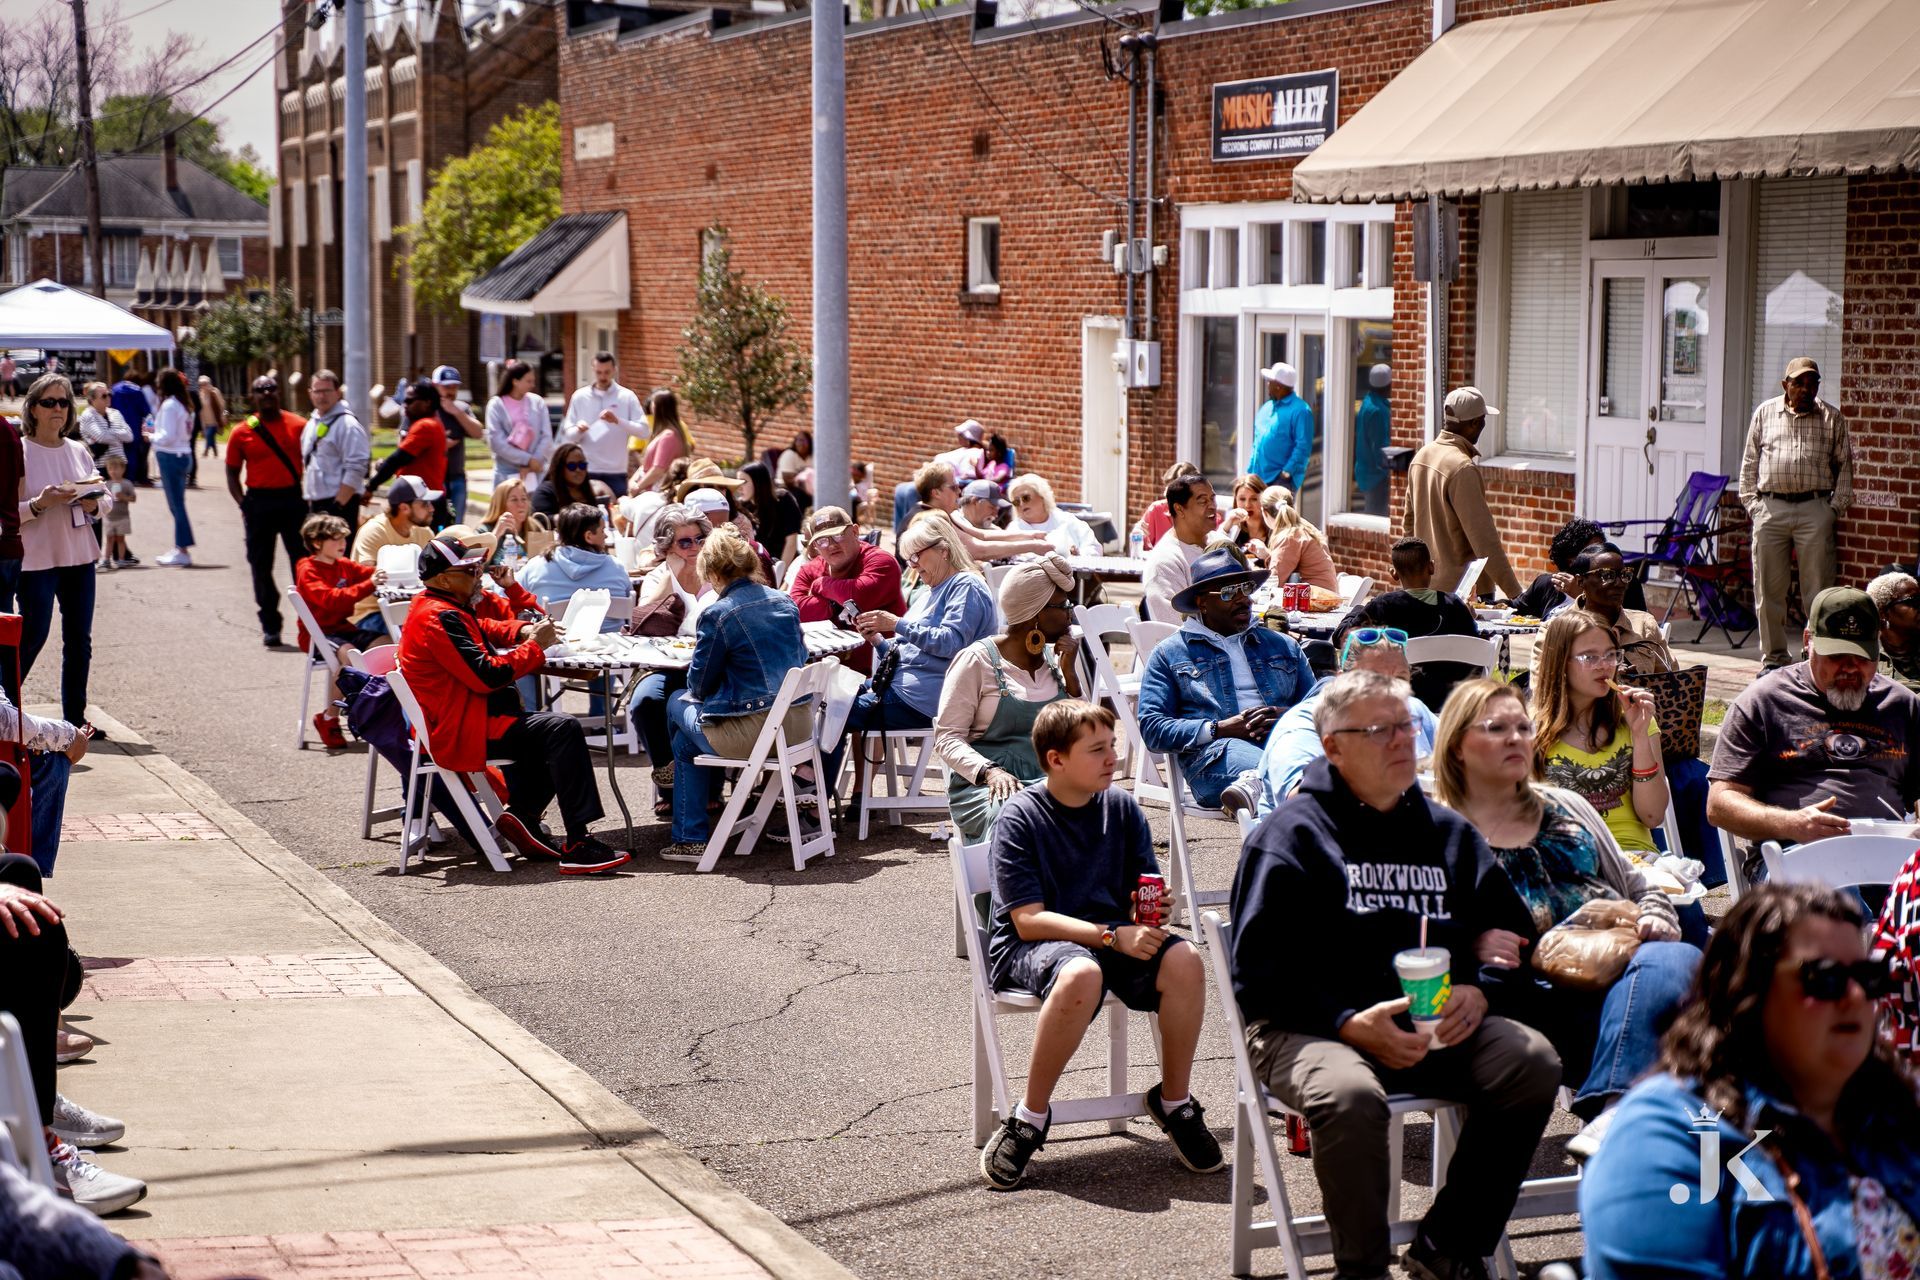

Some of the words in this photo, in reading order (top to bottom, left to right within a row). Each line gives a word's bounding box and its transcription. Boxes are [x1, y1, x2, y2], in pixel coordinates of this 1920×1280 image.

[1221, 92, 1272, 129] MUSIC
[1272, 85, 1329, 125] ALLEY
[1221, 141, 1249, 154] RECORDING
[1249, 139, 1273, 152] COMPANY
[1279, 136, 1303, 149] LEARNING
[1643, 239, 1656, 256] 114
[1138, 886, 1163, 902] Peppe
